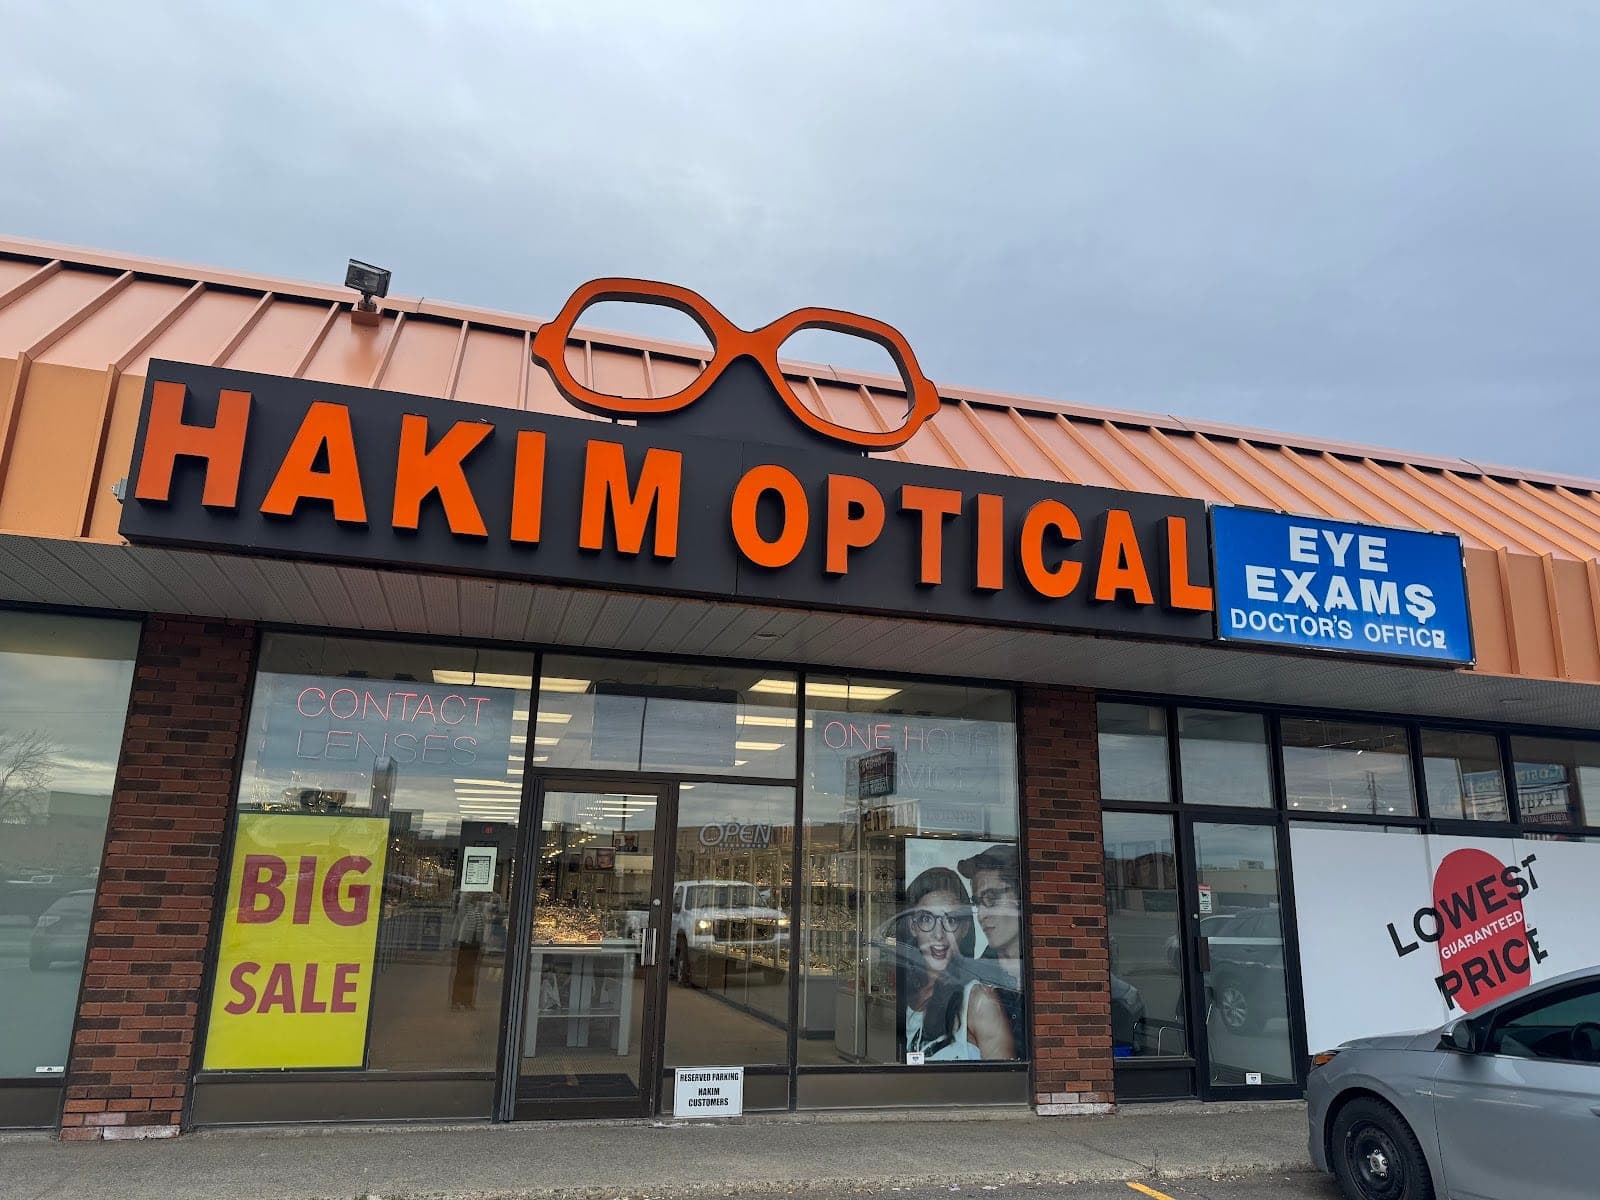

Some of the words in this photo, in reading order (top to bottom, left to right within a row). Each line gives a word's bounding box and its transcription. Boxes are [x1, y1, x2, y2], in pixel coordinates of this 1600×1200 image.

[134, 380, 683, 560] HAKIM
[731, 464, 1214, 612] OPTICAL
[1289, 526, 1388, 573] EYE
[1245, 565, 1436, 624] EXAMS
[1230, 608, 1353, 640] DOCTOR'S
[297, 687, 490, 727] CONTACT
[296, 730, 478, 766] LENSES
[824, 721, 892, 751] ONE
[699, 822, 772, 847] OPEN
[236, 854, 373, 927] BIG
[1386, 853, 1539, 958] LOWEST
[1441, 910, 1523, 960] GUARANTEED
[223, 961, 361, 1016] SALE
[1434, 927, 1549, 1011] PRICE
[680, 1073, 711, 1082] RESERVED
[712, 1072, 739, 1081] PARKING
[698, 1087, 720, 1096] HAKIM
[688, 1098, 729, 1107] CUSTOMERS
